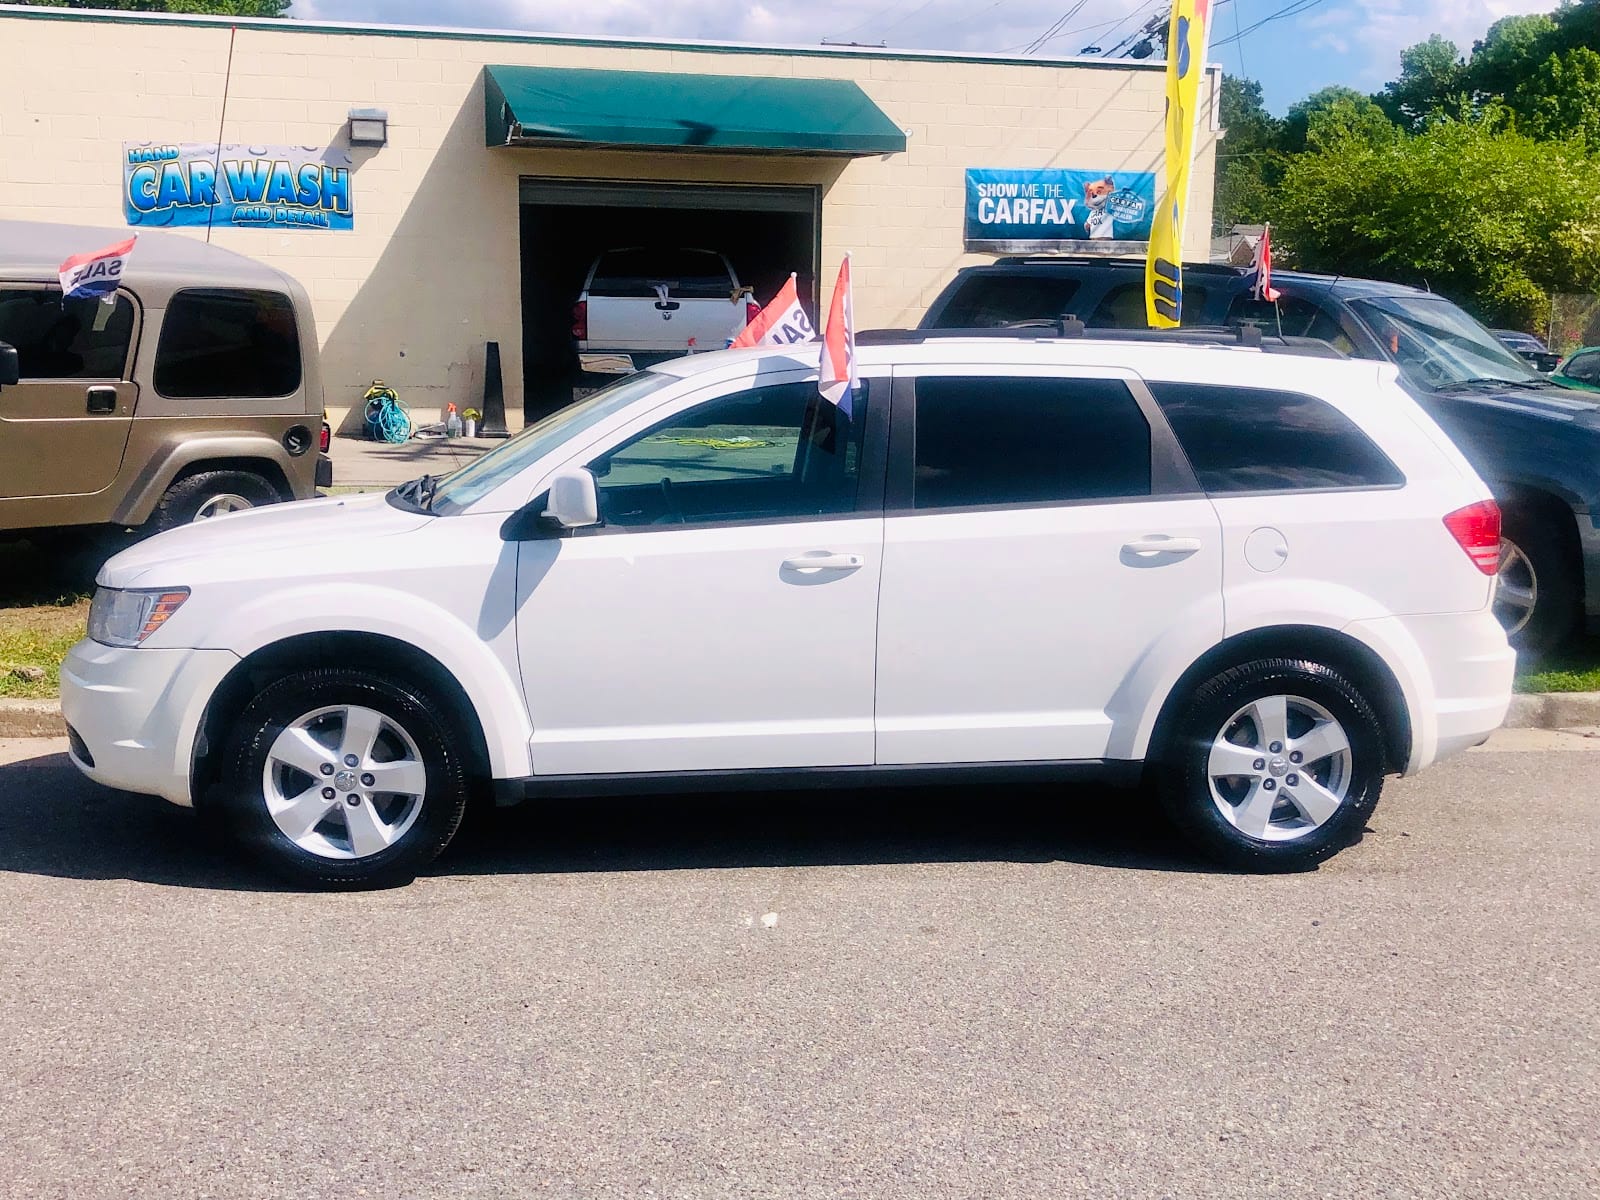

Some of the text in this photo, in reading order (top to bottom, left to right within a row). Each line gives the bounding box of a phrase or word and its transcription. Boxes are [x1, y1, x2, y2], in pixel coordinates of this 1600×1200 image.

[128, 145, 179, 164] HAND
[129, 160, 350, 213] CAR WASH
[978, 183, 1064, 198] SHOW ME THE
[232, 206, 271, 223] AND
[978, 198, 1076, 224] CARFAX
